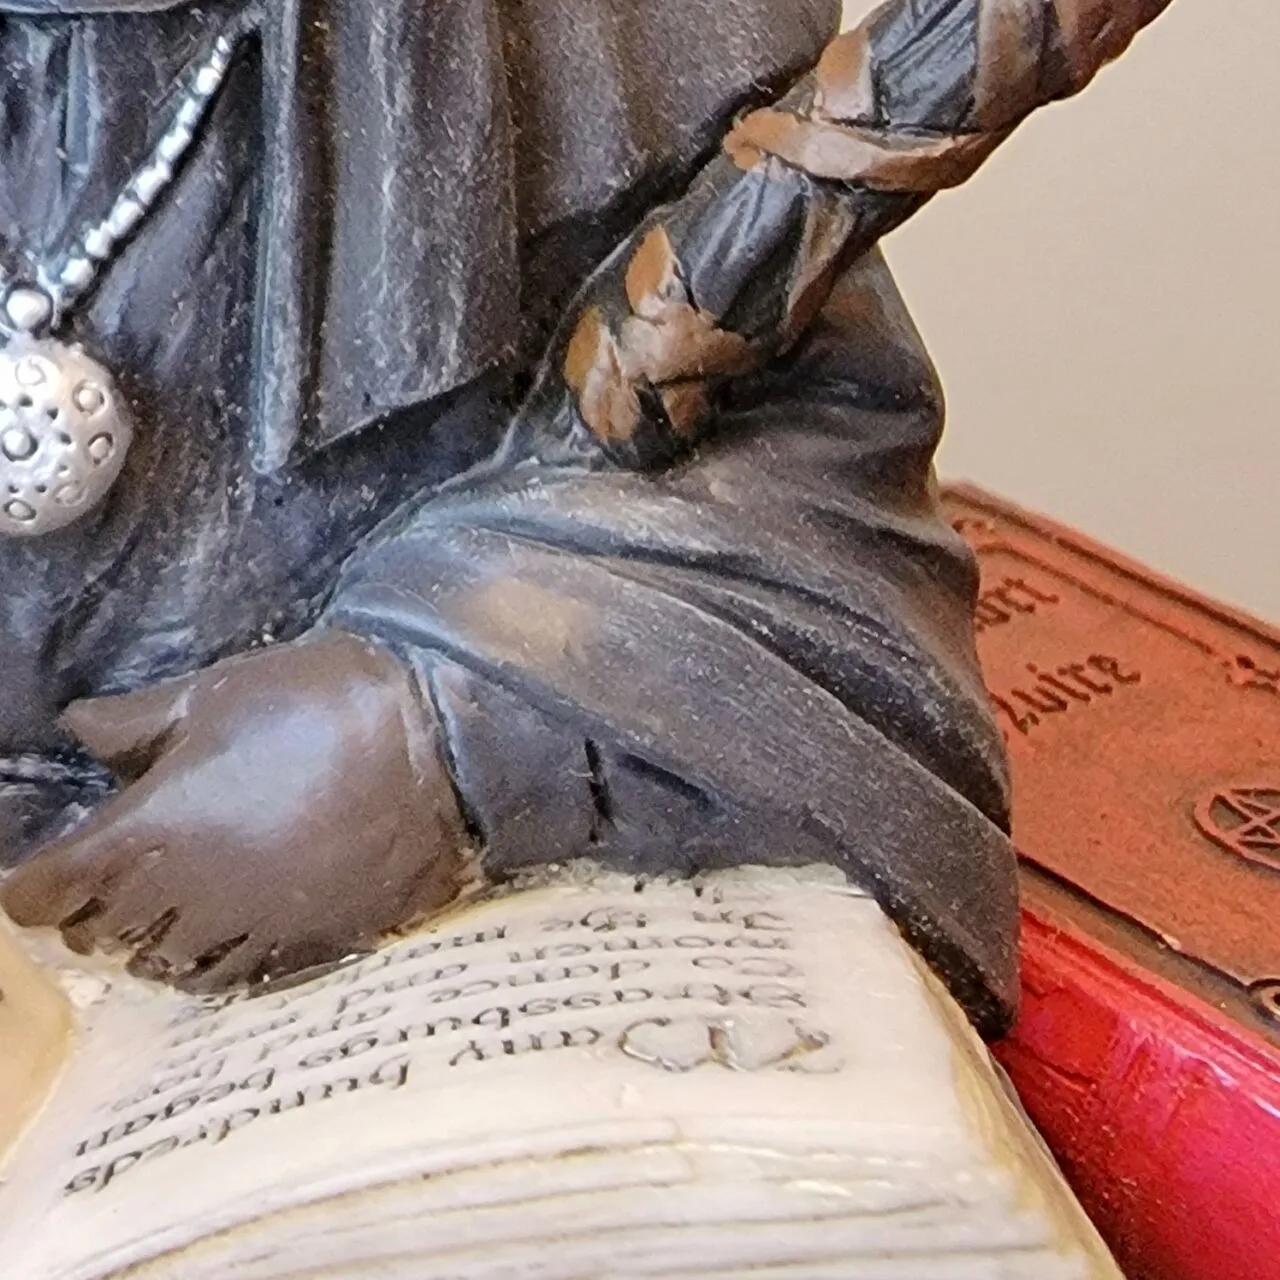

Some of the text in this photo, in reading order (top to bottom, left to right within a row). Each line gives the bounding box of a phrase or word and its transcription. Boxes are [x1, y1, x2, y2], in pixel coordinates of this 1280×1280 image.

[335, 962, 474, 1016] and
[426, 958, 652, 1004] dance
[255, 1004, 391, 1064] and
[63, 1014, 841, 1198] Many hundreds
[74, 1066, 277, 1158] began
